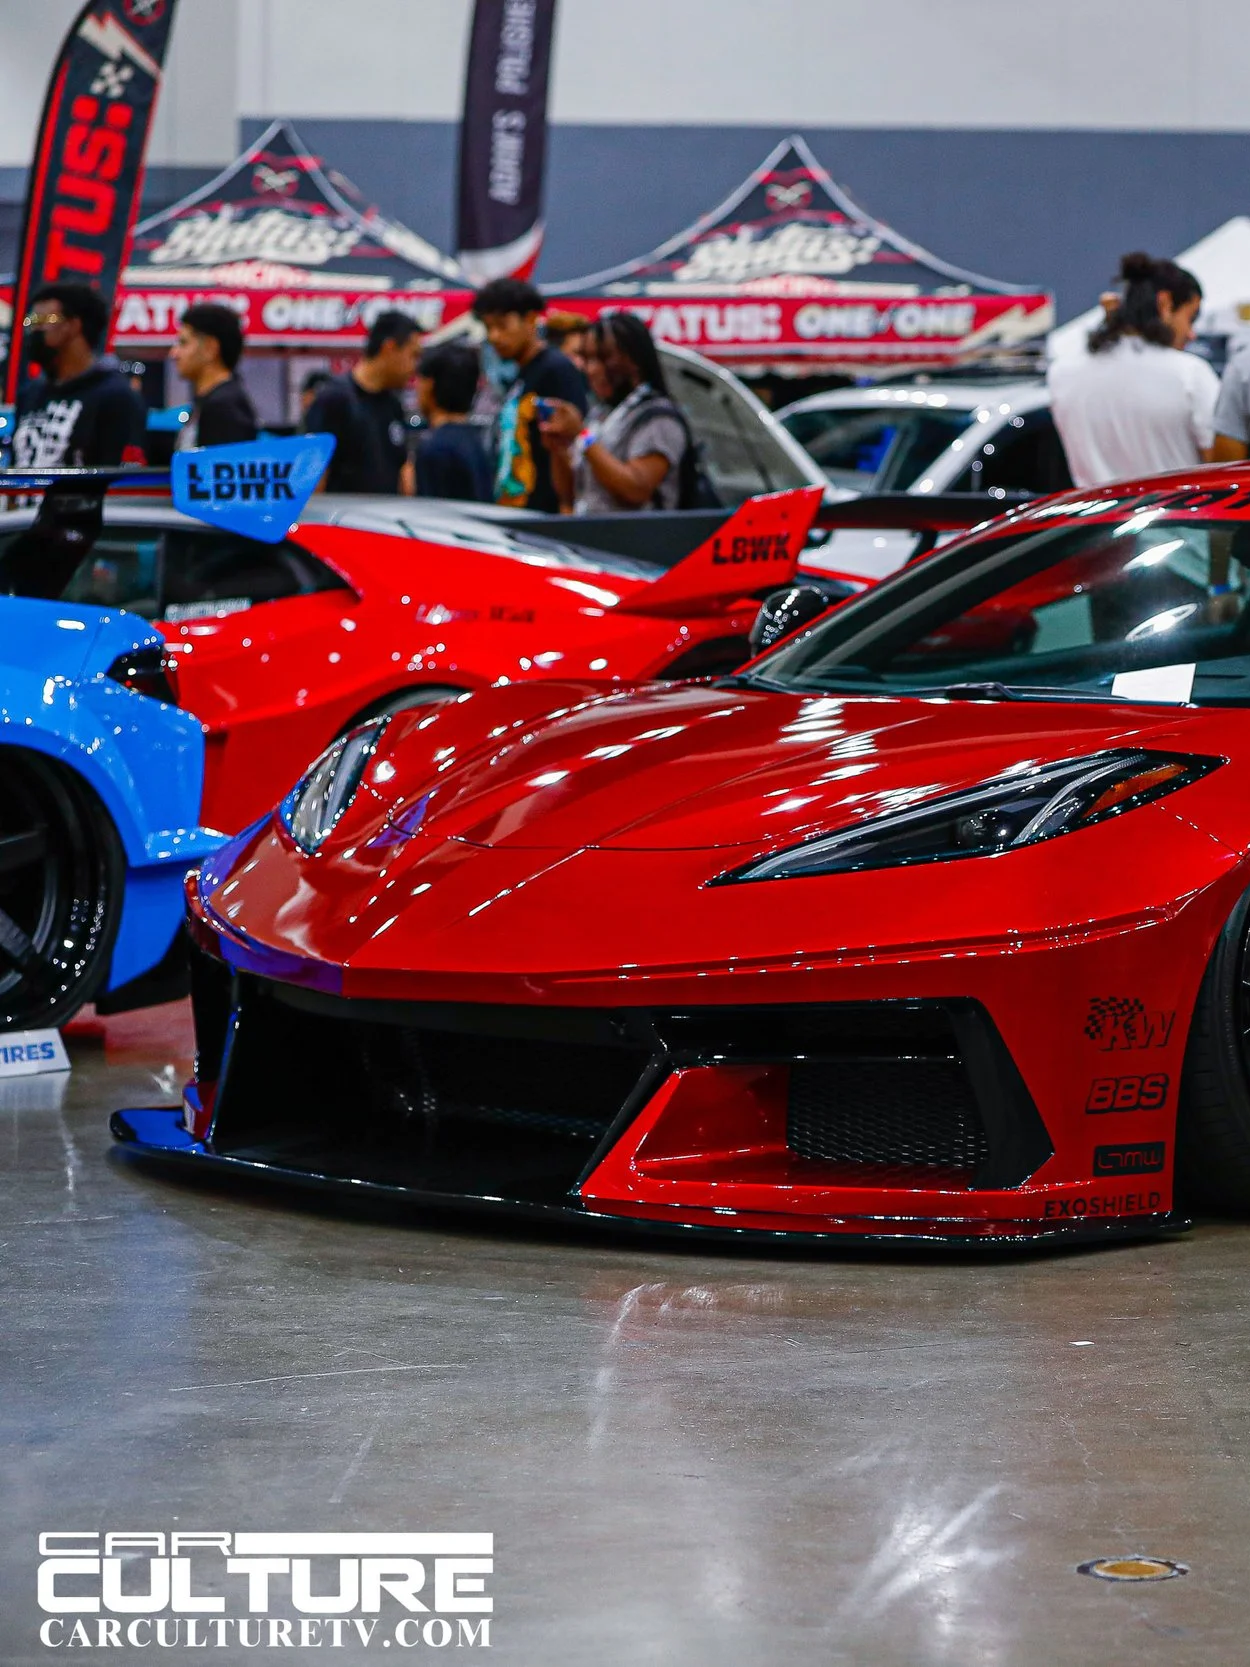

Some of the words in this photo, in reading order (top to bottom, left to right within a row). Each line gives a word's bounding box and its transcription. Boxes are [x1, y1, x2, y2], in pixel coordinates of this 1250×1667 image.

[188, 462, 296, 500] LBWK
[711, 532, 792, 566] LBWK
[1085, 1072, 1170, 1115] BBS
[1044, 1191, 1161, 1218] EXOSHIELD
